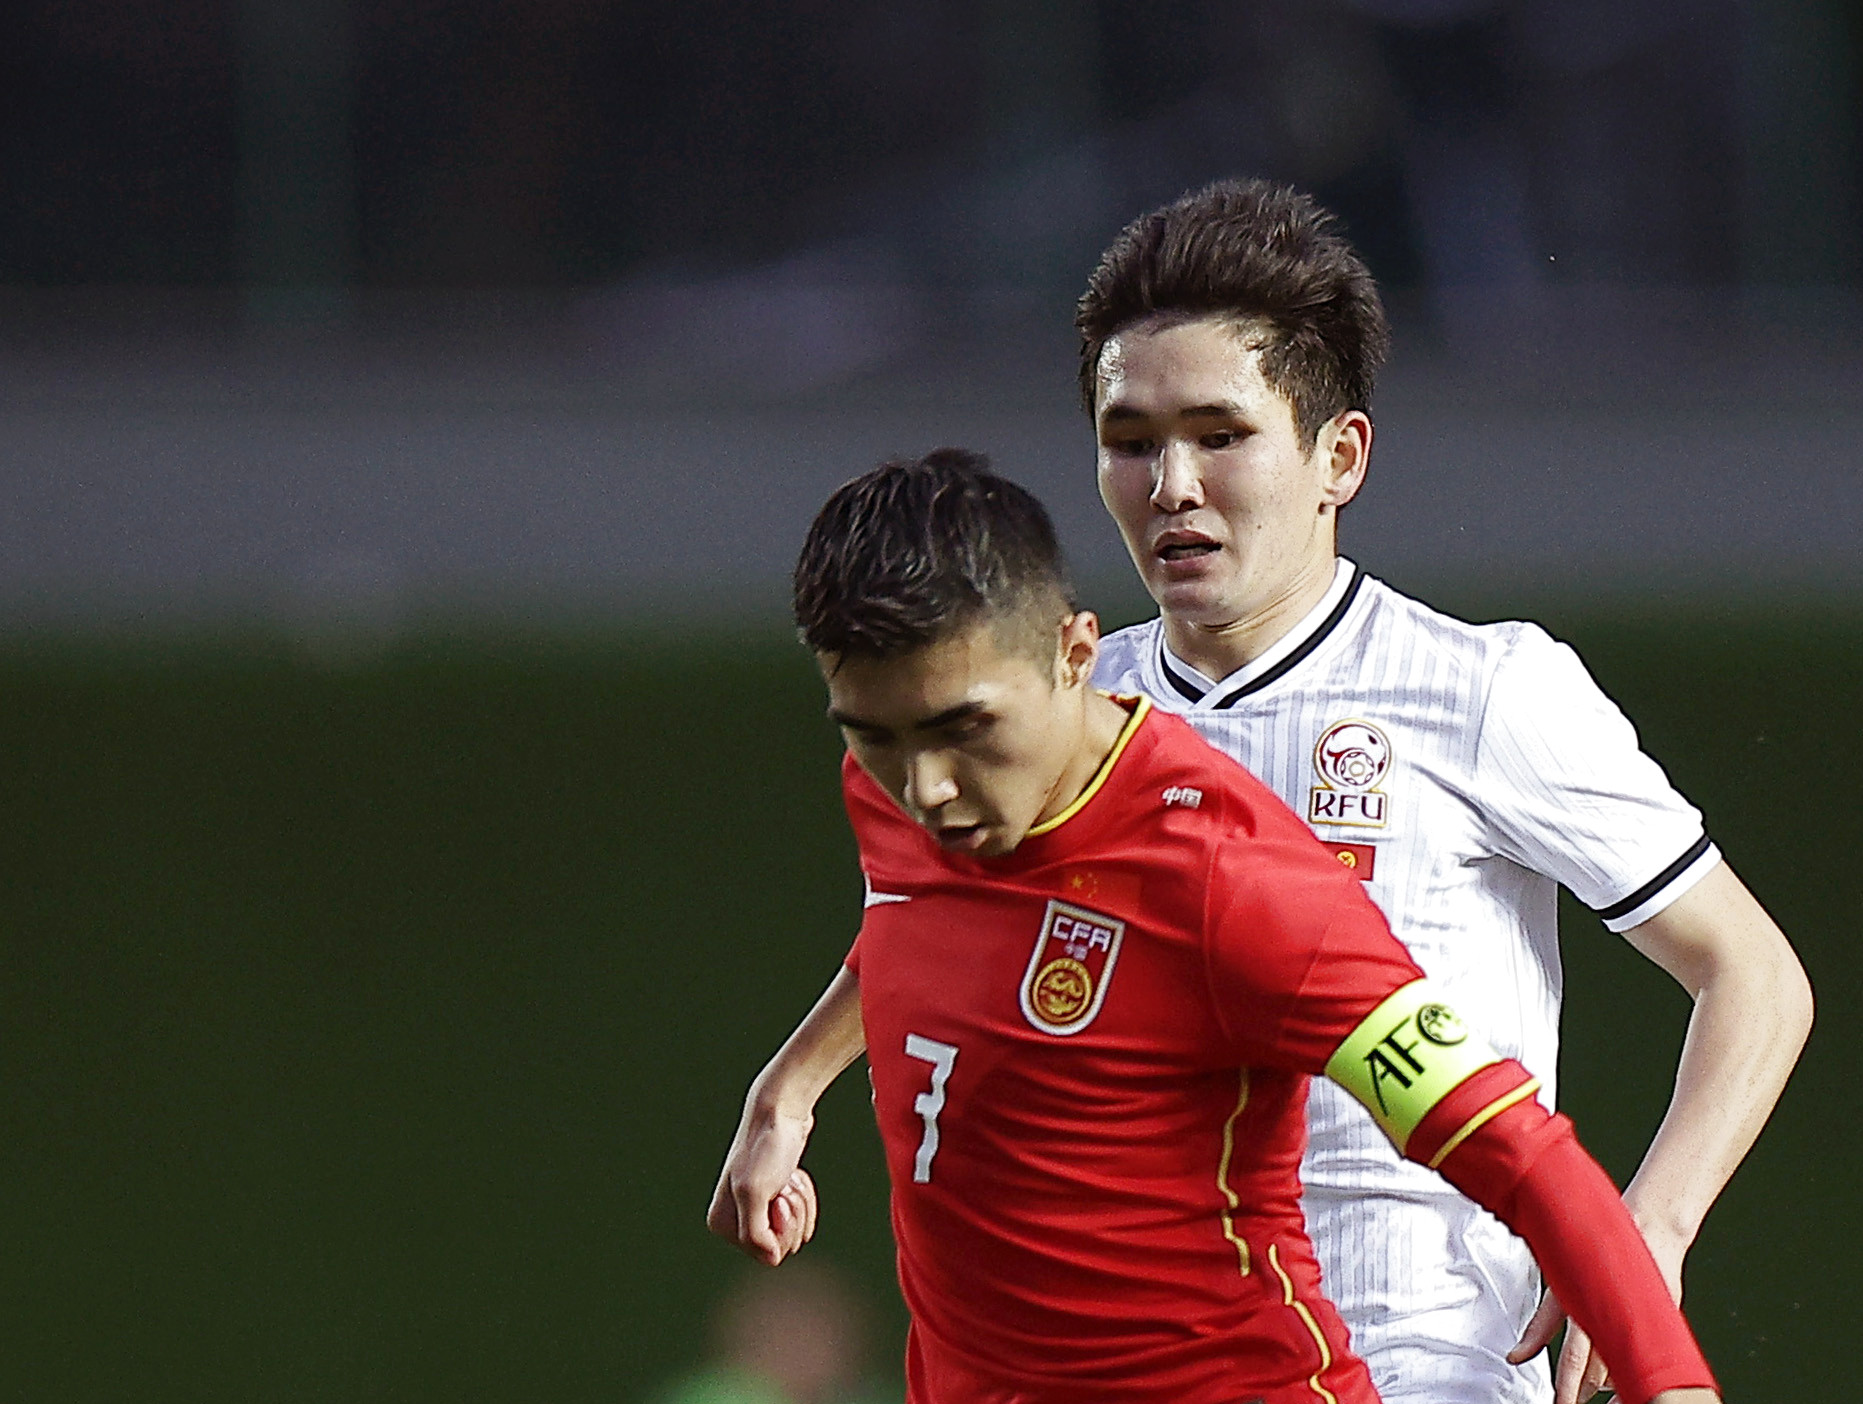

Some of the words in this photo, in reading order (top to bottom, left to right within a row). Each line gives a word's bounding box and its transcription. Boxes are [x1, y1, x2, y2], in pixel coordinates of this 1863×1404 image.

[1052, 915, 1112, 952] CFA
[905, 1034, 961, 1184] 7
[1363, 1004, 1468, 1117] AFC
